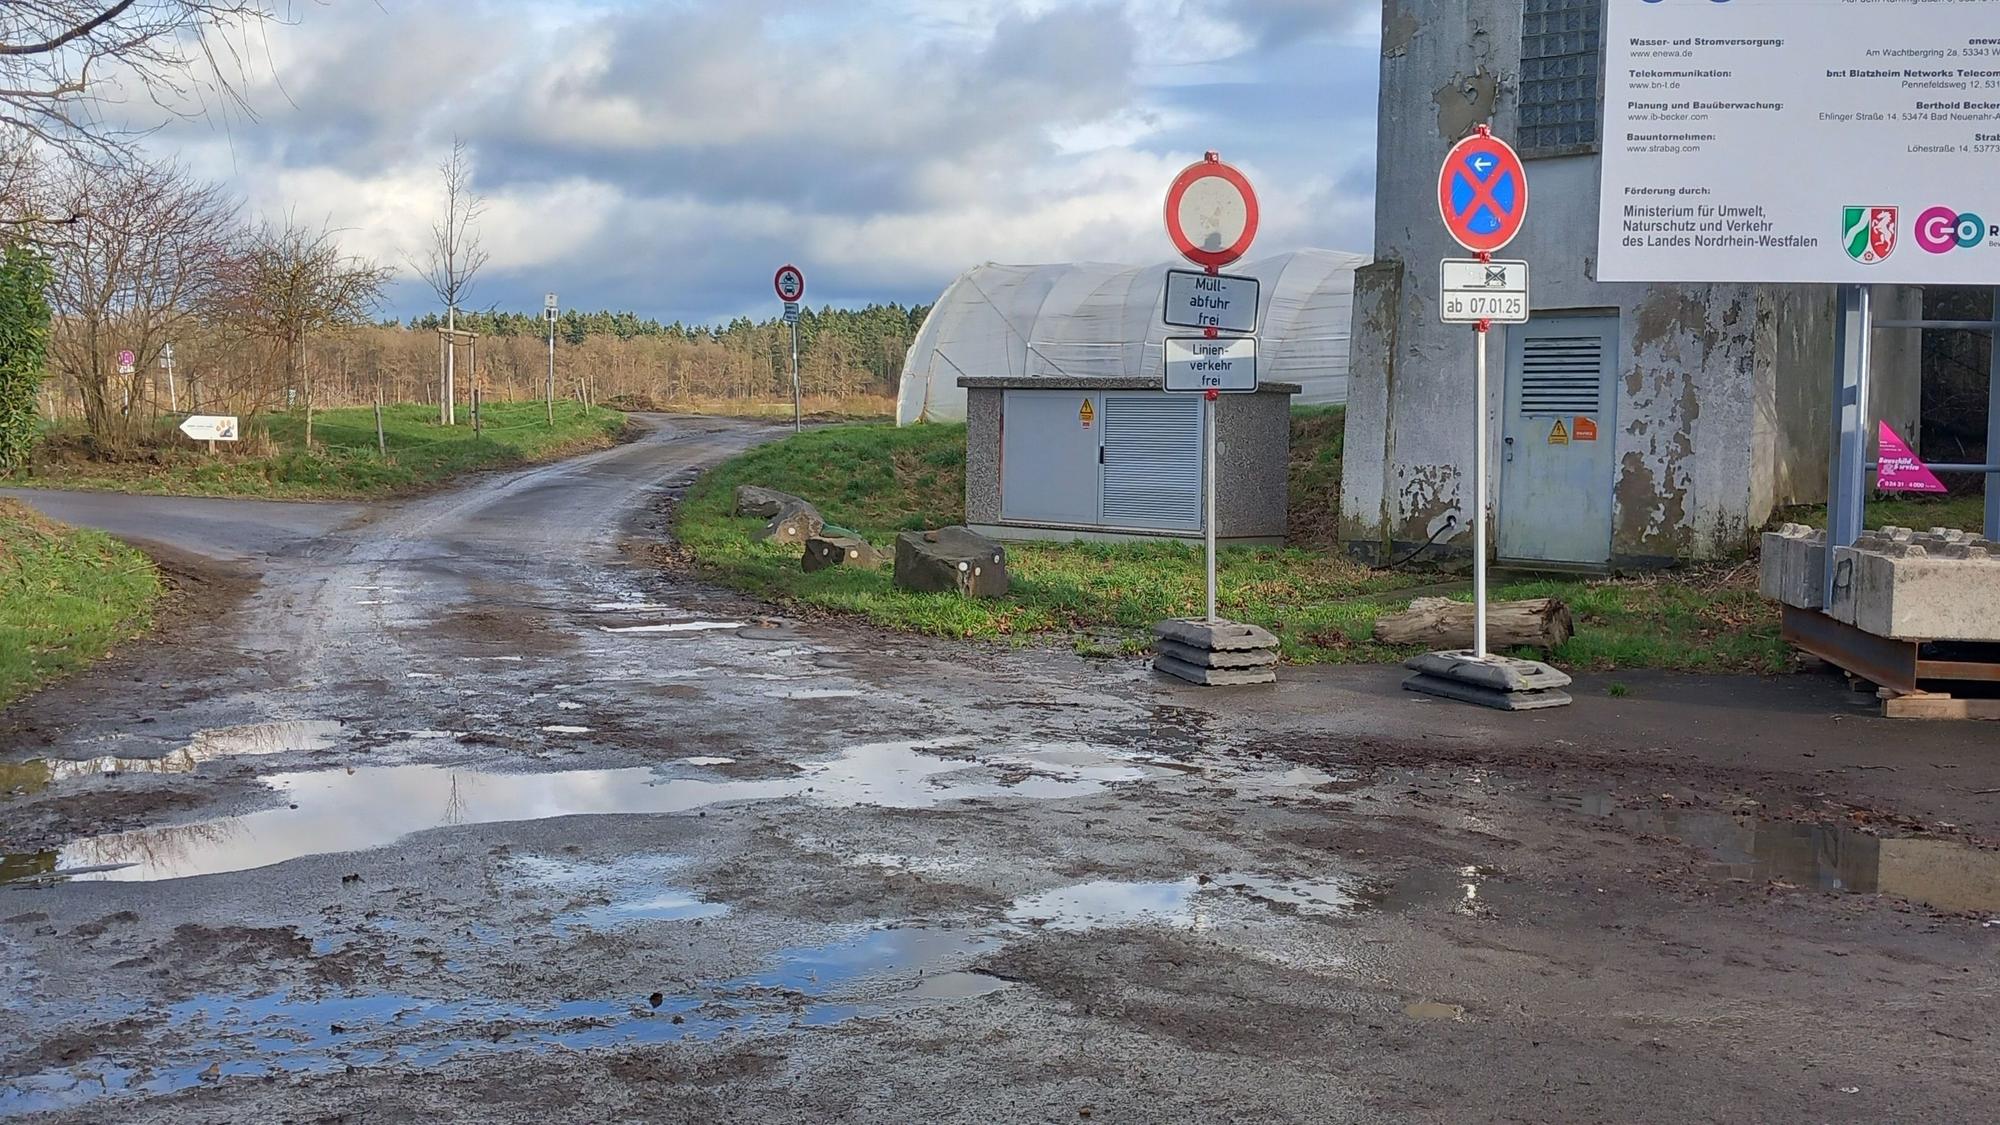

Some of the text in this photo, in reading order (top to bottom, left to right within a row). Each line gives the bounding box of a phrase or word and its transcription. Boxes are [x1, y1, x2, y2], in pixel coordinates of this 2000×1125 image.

[1630, 38, 1785, 47] Wasser- und Stromversorgung:
[1882, 49, 1944, 58] Wachtbergring
[1849, 69, 1900, 77] Blatzheim
[1903, 69, 1953, 77] Networks
[1901, 81, 1966, 90] Pennefeldsweg
[1628, 102, 1668, 110] Planung
[1693, 101, 1784, 110] Bauüberwachung:
[1916, 101, 2000, 109] Berthold Becker
[1628, 113, 1708, 121] www.ib-becker.com
[1819, 112, 1853, 121] Ehlinger
[1855, 112, 1884, 120] Straße
[1627, 133, 1716, 141] Bauunternehmen:
[1627, 145, 1700, 153] www.strabag.com
[1907, 145, 1955, 153] Löhestraße
[1624, 186, 1711, 196] Förderung durch:
[1623, 205, 1766, 218] Ministerium für Umwelt,
[1623, 220, 1773, 232] Naturschutz und Verkehr
[1622, 235, 1818, 247] des Landes Nordrhein-Westfalen
[1195, 278, 1227, 292] Müll-
[1190, 296, 1230, 310] abfuhr
[1447, 297, 1520, 313] ab 07.01.25
[1198, 312, 1219, 326] frei
[1193, 344, 1229, 356] Linien-
[1190, 360, 1232, 371] verkehr
[1202, 375, 1220, 386] frei
